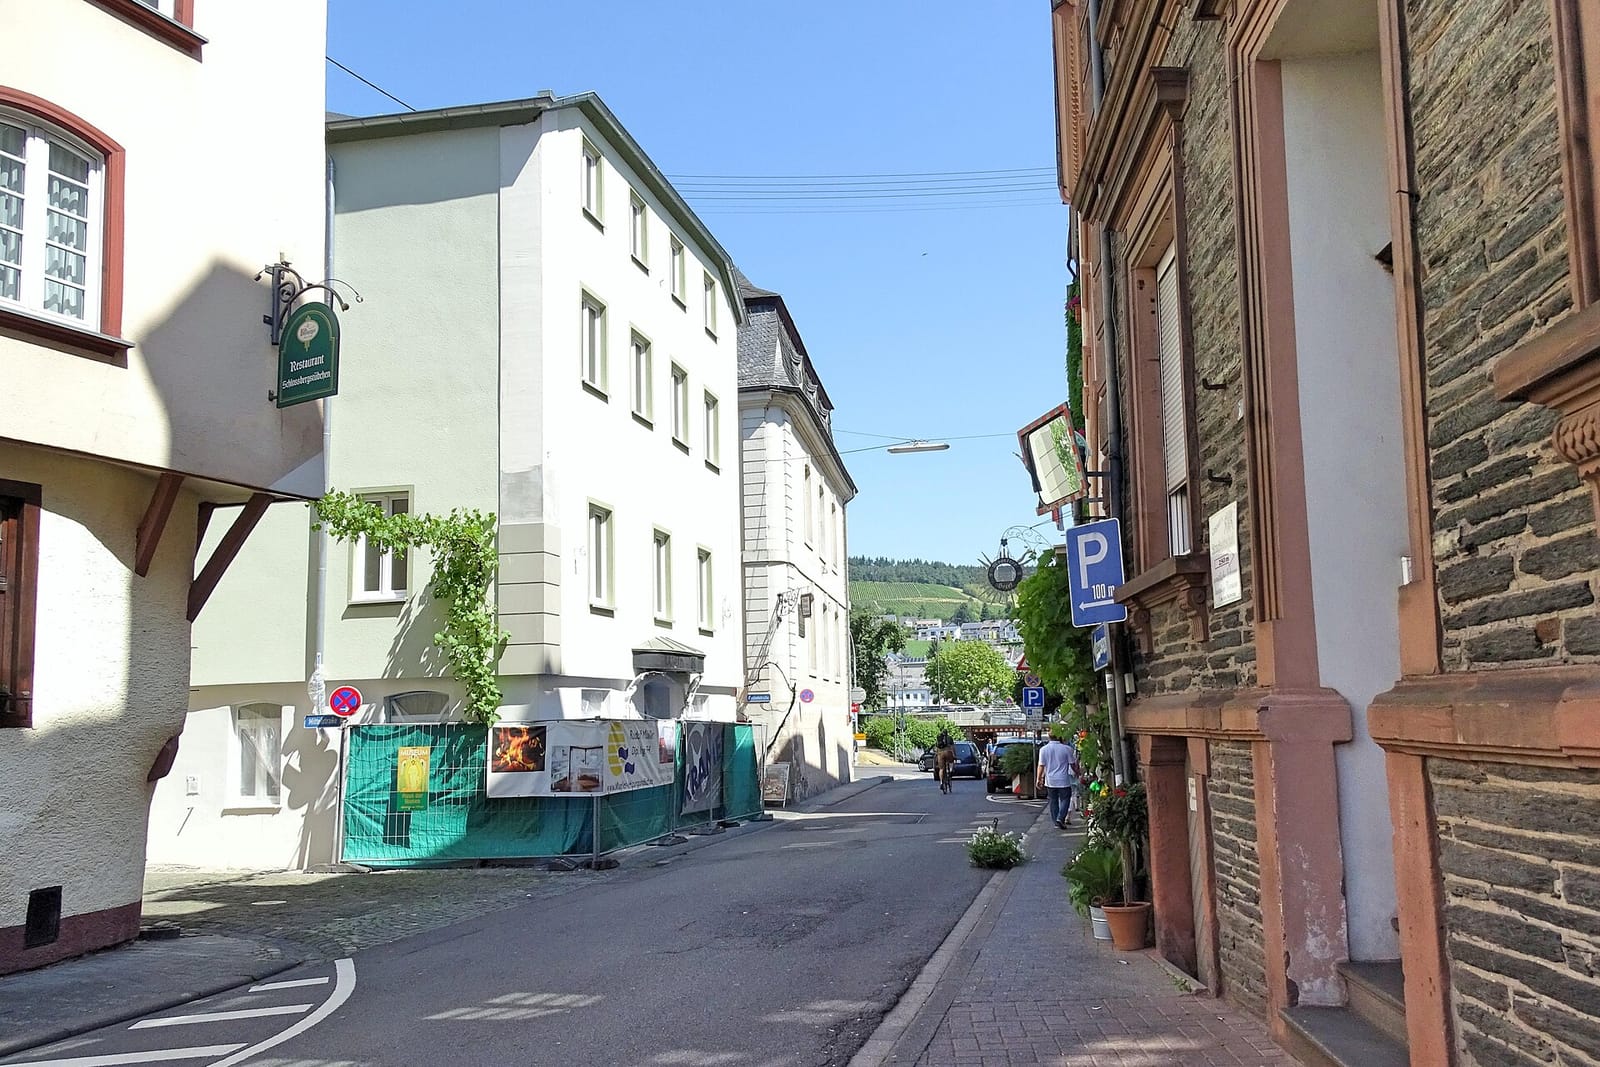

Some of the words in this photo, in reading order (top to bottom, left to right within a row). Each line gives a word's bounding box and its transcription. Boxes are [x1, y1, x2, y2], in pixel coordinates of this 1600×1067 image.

[290, 354, 325, 373] Restaurant
[1077, 532, 1108, 589] P
[1091, 583, 1106, 600] 100
[1107, 585, 1115, 598] m
[1028, 690, 1039, 705] P
